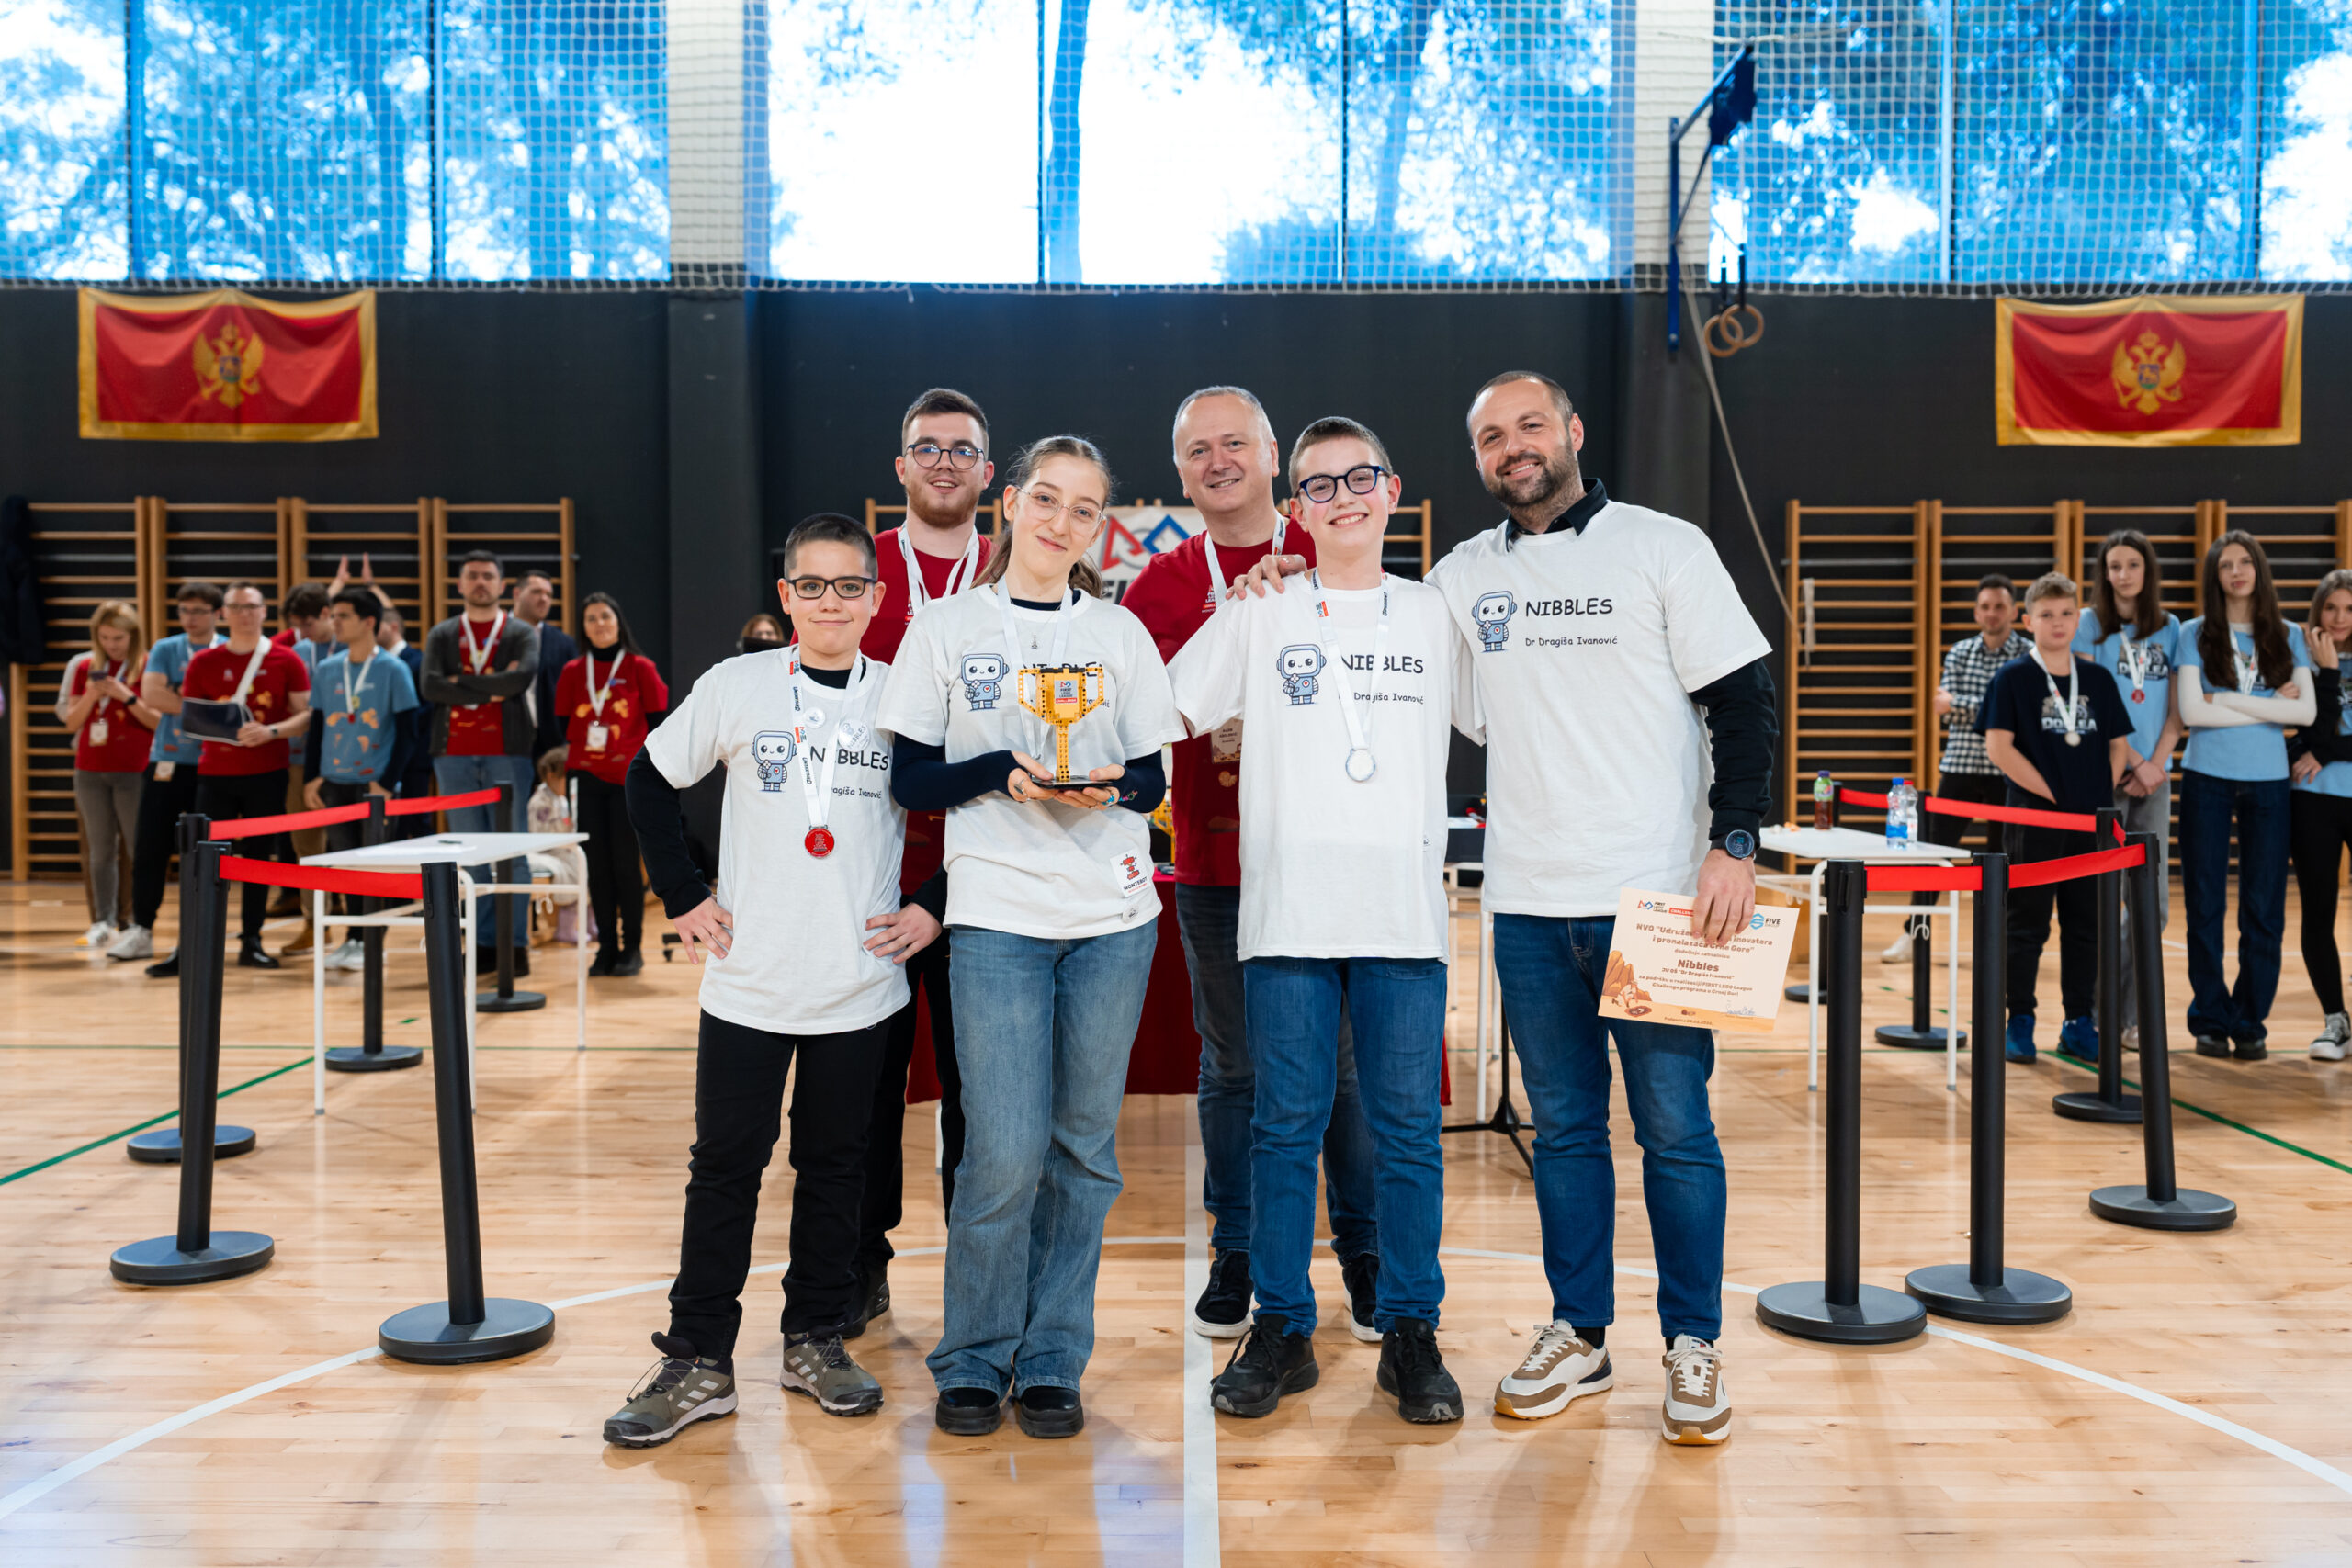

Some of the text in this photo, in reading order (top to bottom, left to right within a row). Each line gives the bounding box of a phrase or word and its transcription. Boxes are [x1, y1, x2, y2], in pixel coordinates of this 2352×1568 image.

[1526, 598, 1613, 617] NIBBLES
[1525, 636, 1618, 648] Dr Dragiša Ivanović
[1392, 693, 1424, 705] Ivanović
[810, 746, 888, 771] NBBLES
[831, 786, 882, 799] agiša Ivanović
[1636, 923, 1772, 945] NVO "Udruže inovatora
[1678, 959, 1719, 972] Nibbles
